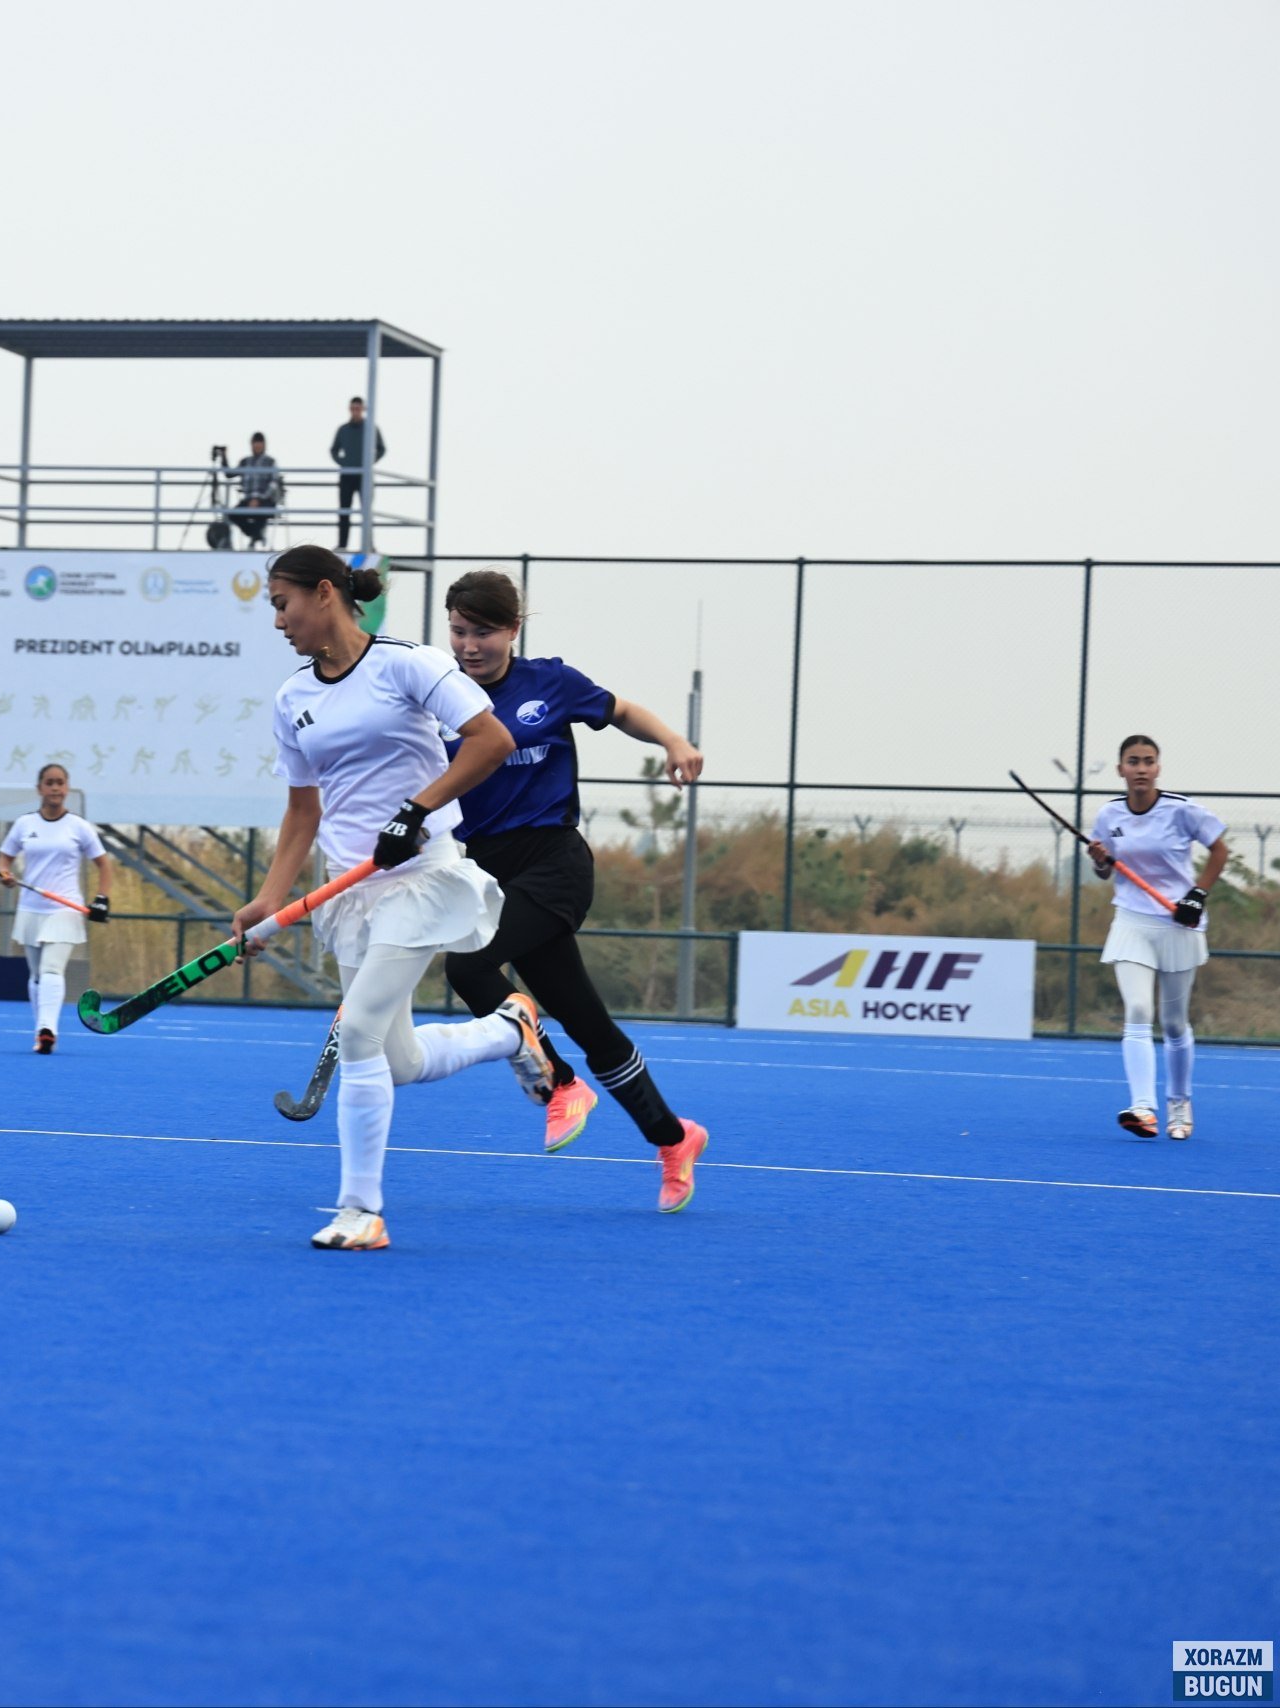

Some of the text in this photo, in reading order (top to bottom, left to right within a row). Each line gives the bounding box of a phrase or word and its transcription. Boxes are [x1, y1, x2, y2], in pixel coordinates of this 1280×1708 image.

[14, 638, 241, 657] PREZIDENT OLIMPIADASI
[790, 949, 983, 991] AHF
[788, 998, 971, 1022] ASIA HOCKEY
